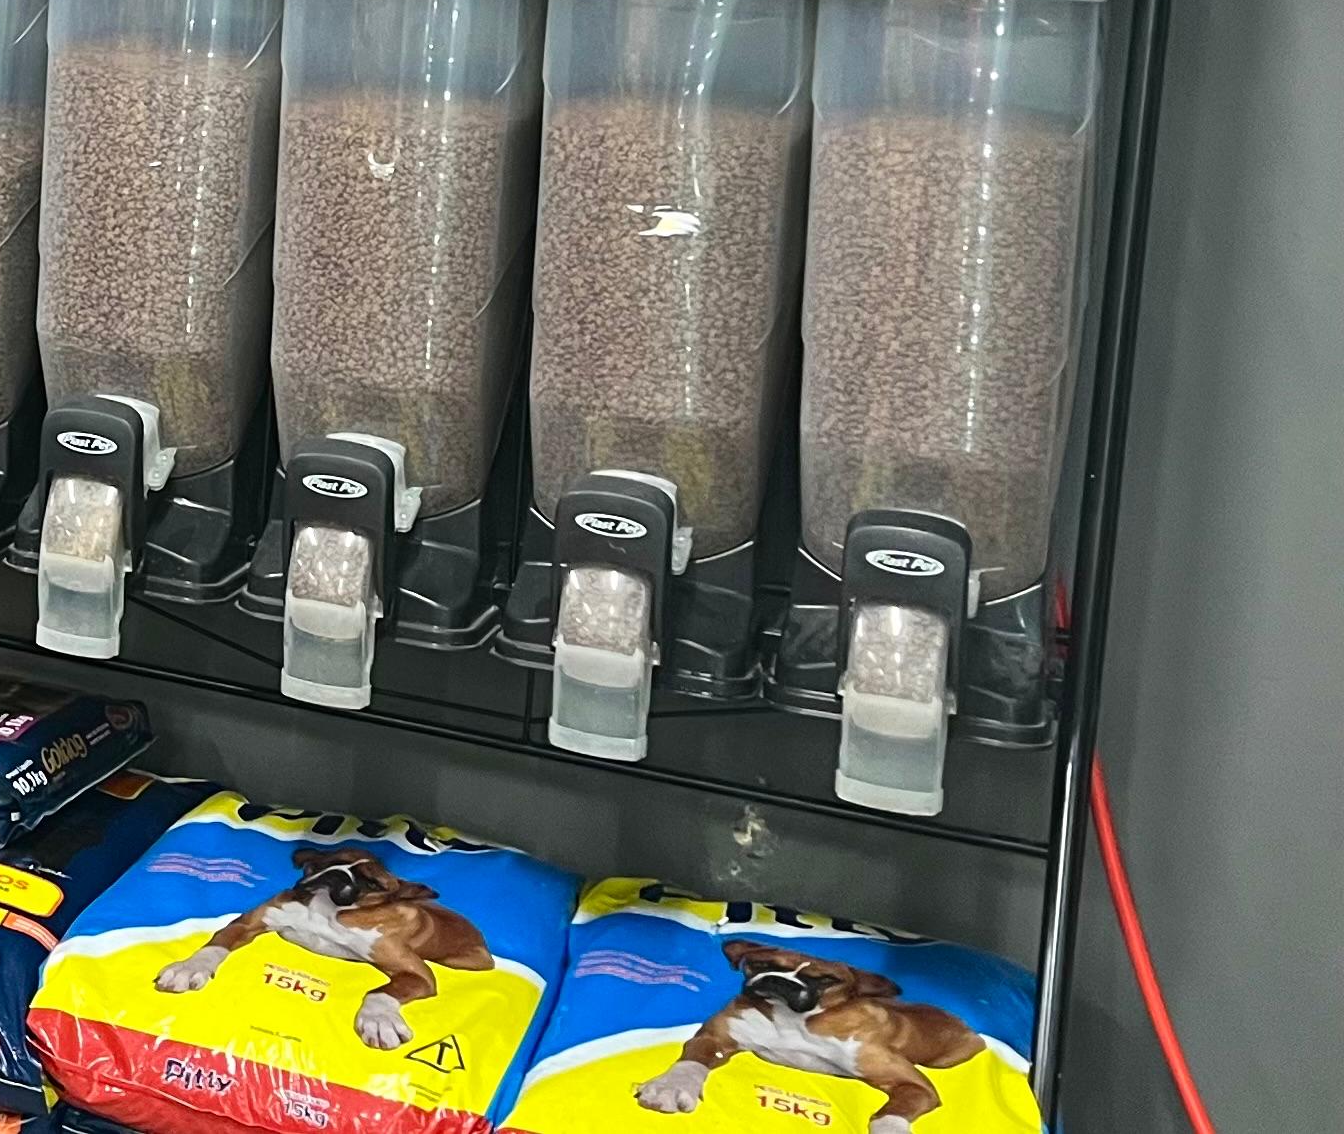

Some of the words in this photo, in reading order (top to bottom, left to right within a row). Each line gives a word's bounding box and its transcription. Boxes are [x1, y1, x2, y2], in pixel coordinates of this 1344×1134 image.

[263, 972, 327, 1003] 15kg
[284, 1099, 328, 1128] 15kg
[756, 1095, 831, 1126] 15kg
